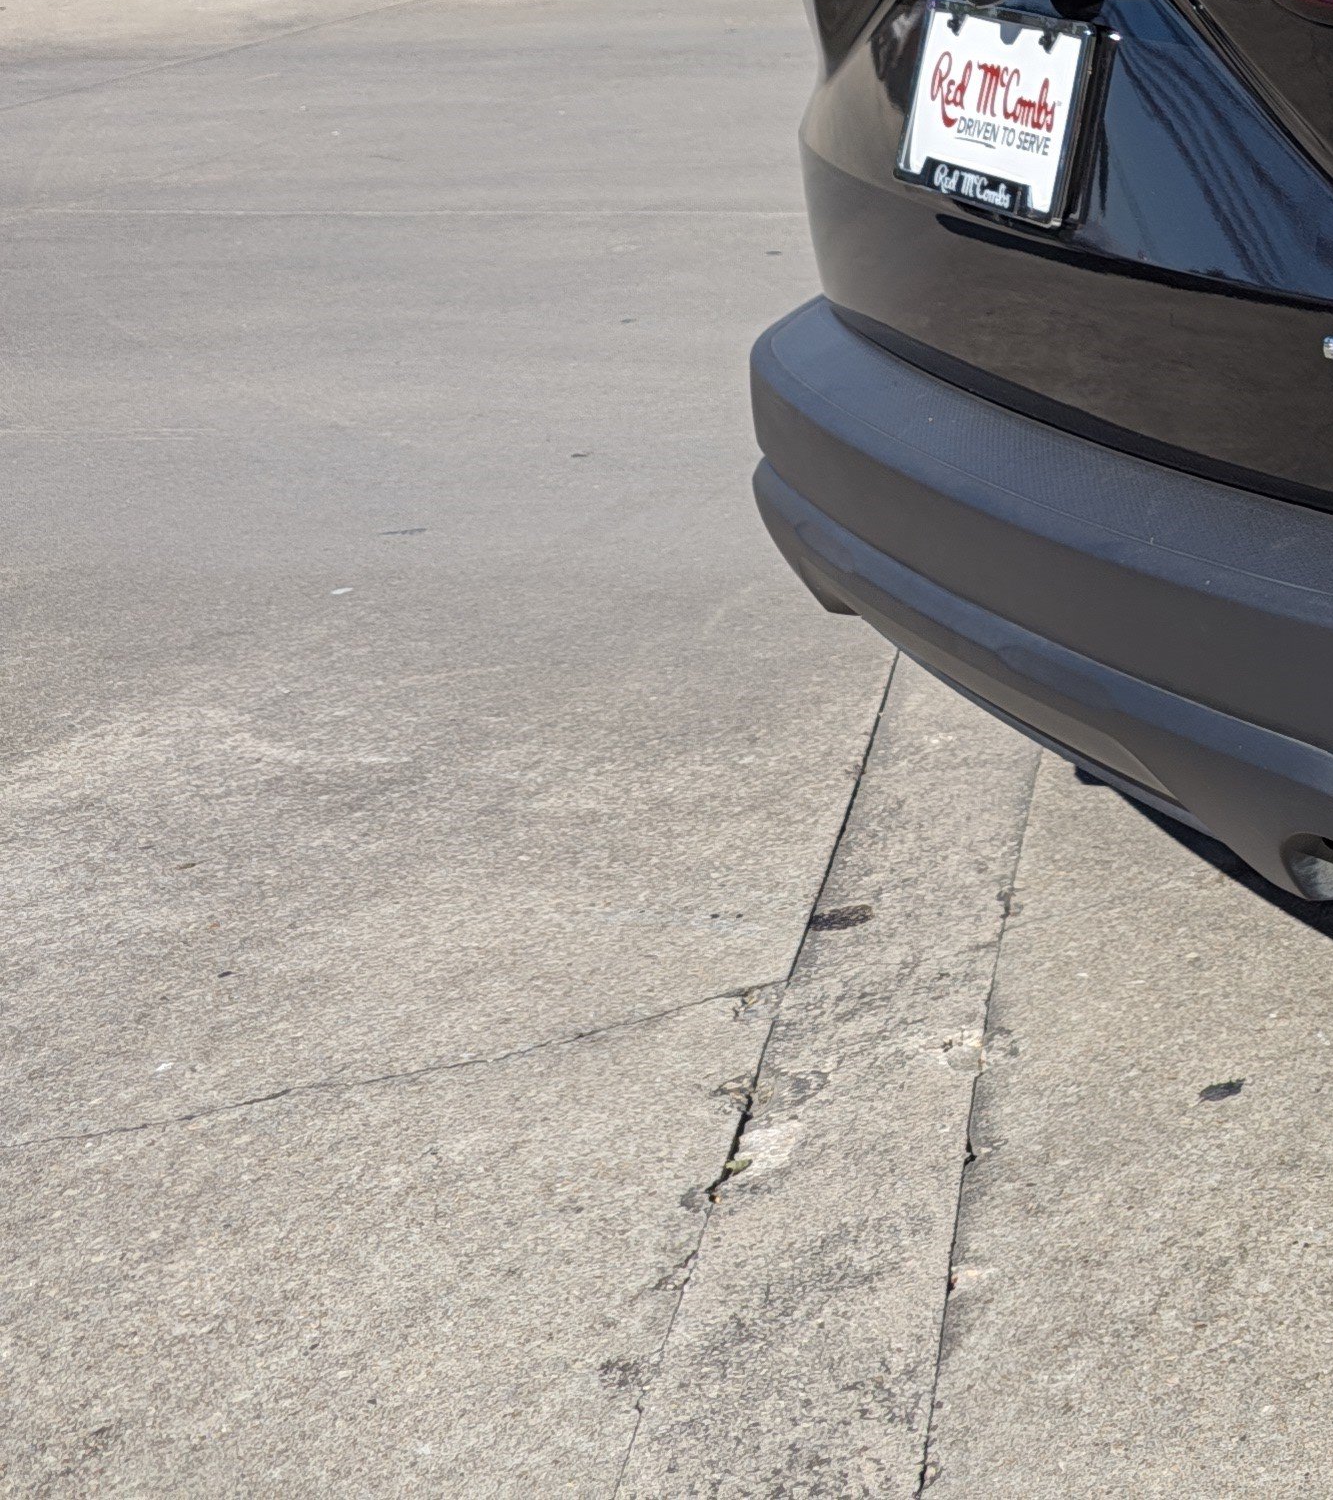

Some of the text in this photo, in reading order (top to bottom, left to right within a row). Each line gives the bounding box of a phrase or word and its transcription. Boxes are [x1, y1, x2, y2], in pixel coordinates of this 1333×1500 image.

[930, 50, 1056, 133] Red McCombs
[957, 115, 1052, 157] DRIVEN TO SERVE
[933, 163, 960, 194] Red
